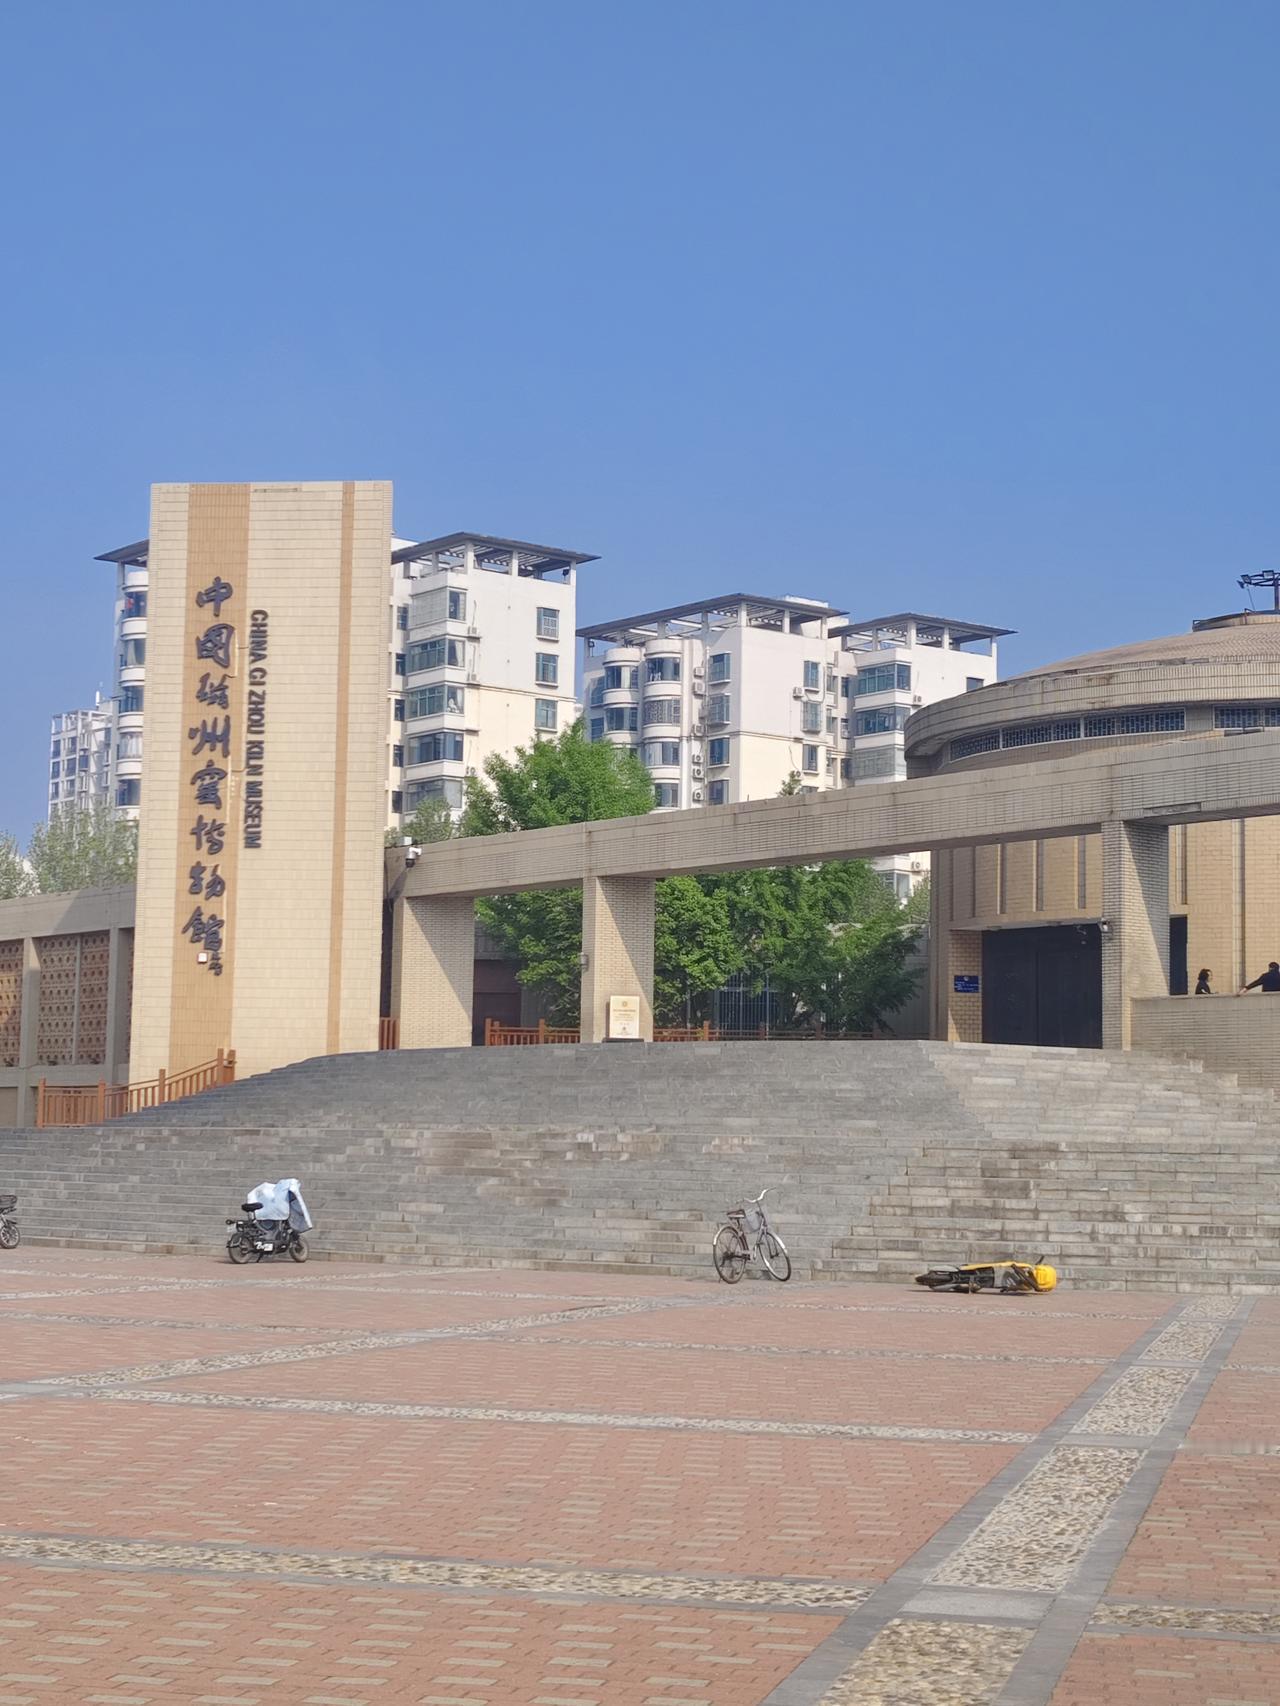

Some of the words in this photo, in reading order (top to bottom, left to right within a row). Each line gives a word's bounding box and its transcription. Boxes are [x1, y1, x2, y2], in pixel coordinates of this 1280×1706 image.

[249, 609, 269, 664] CHINA
[247, 690, 266, 734] ZHOU
[245, 740, 264, 776] KILN
[243, 780, 264, 849] MUSEUM
